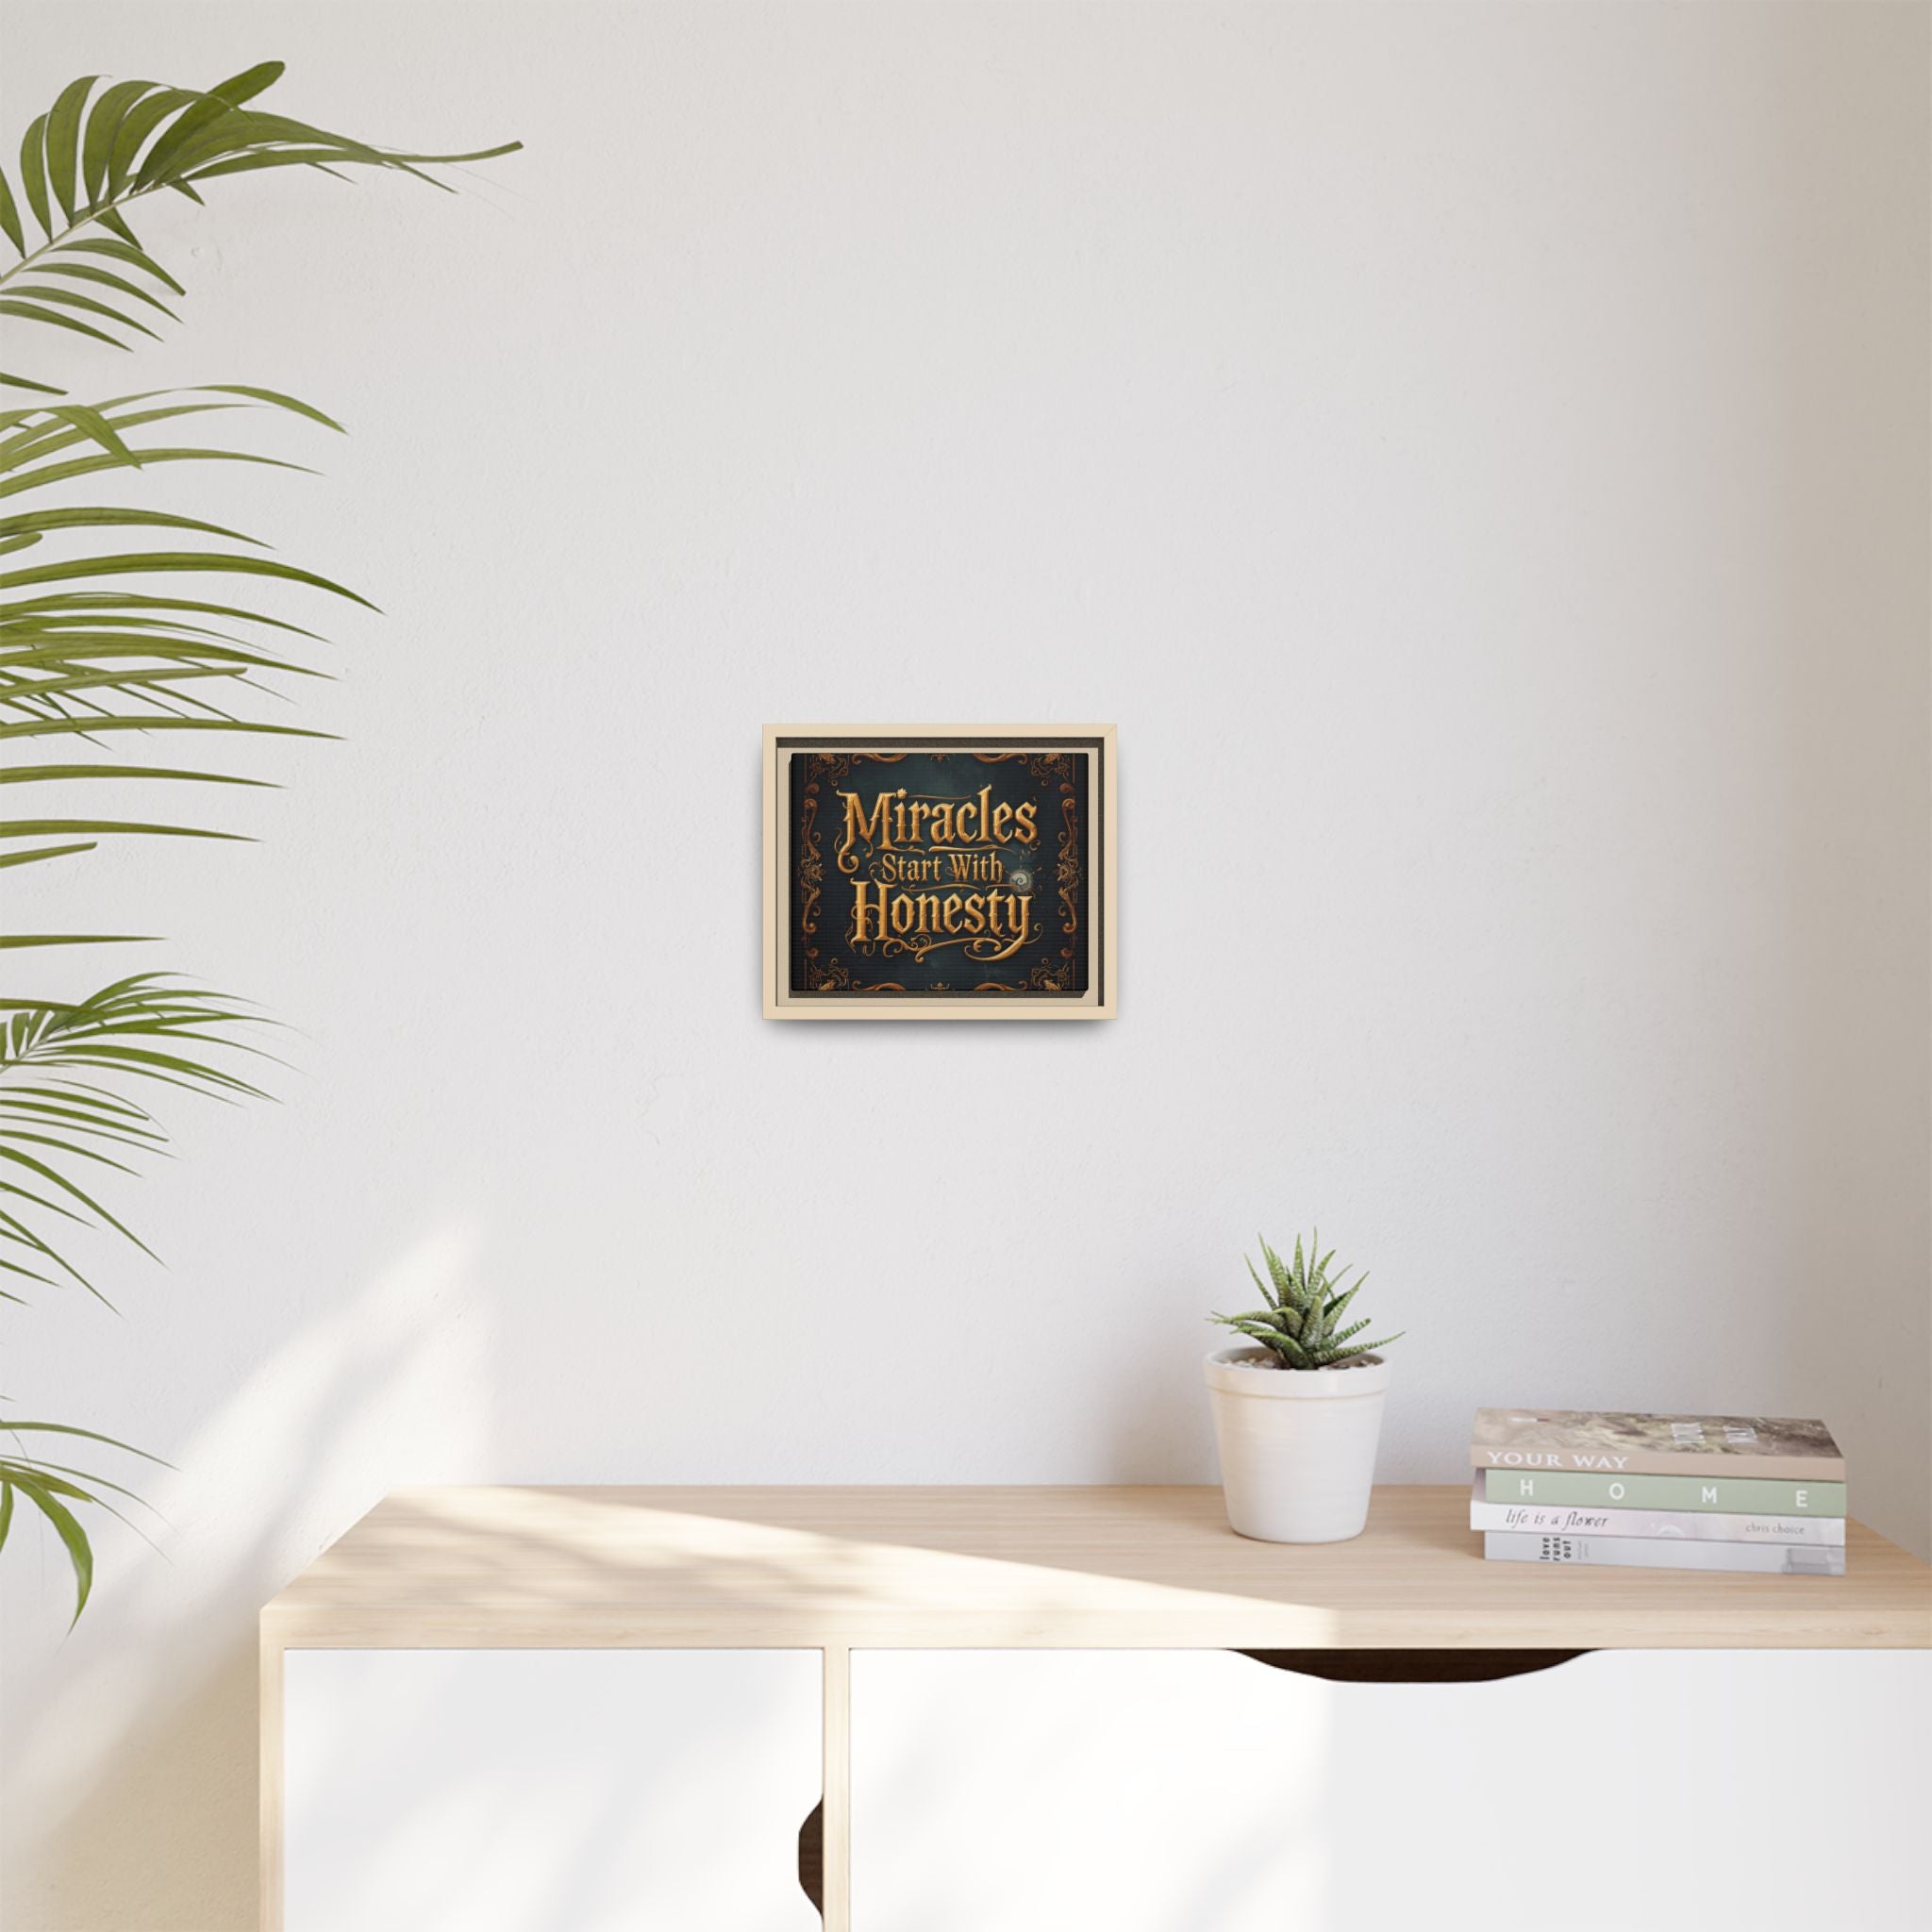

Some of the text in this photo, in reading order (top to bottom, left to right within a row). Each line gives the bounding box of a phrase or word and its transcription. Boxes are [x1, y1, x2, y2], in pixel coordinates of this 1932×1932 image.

[836, 784, 1039, 873] Miracles
[881, 851, 1005, 883] Start With
[849, 878, 1033, 961] Honesty
[1487, 1451, 1629, 1469] YOUR WAY
[1506, 1509, 1609, 1531] life is a flower
[1745, 1521, 1806, 1536] chris choice
[1540, 1537, 1551, 1560] love
[1553, 1537, 1561, 1561] runs
[1562, 1541, 1572, 1559] out
